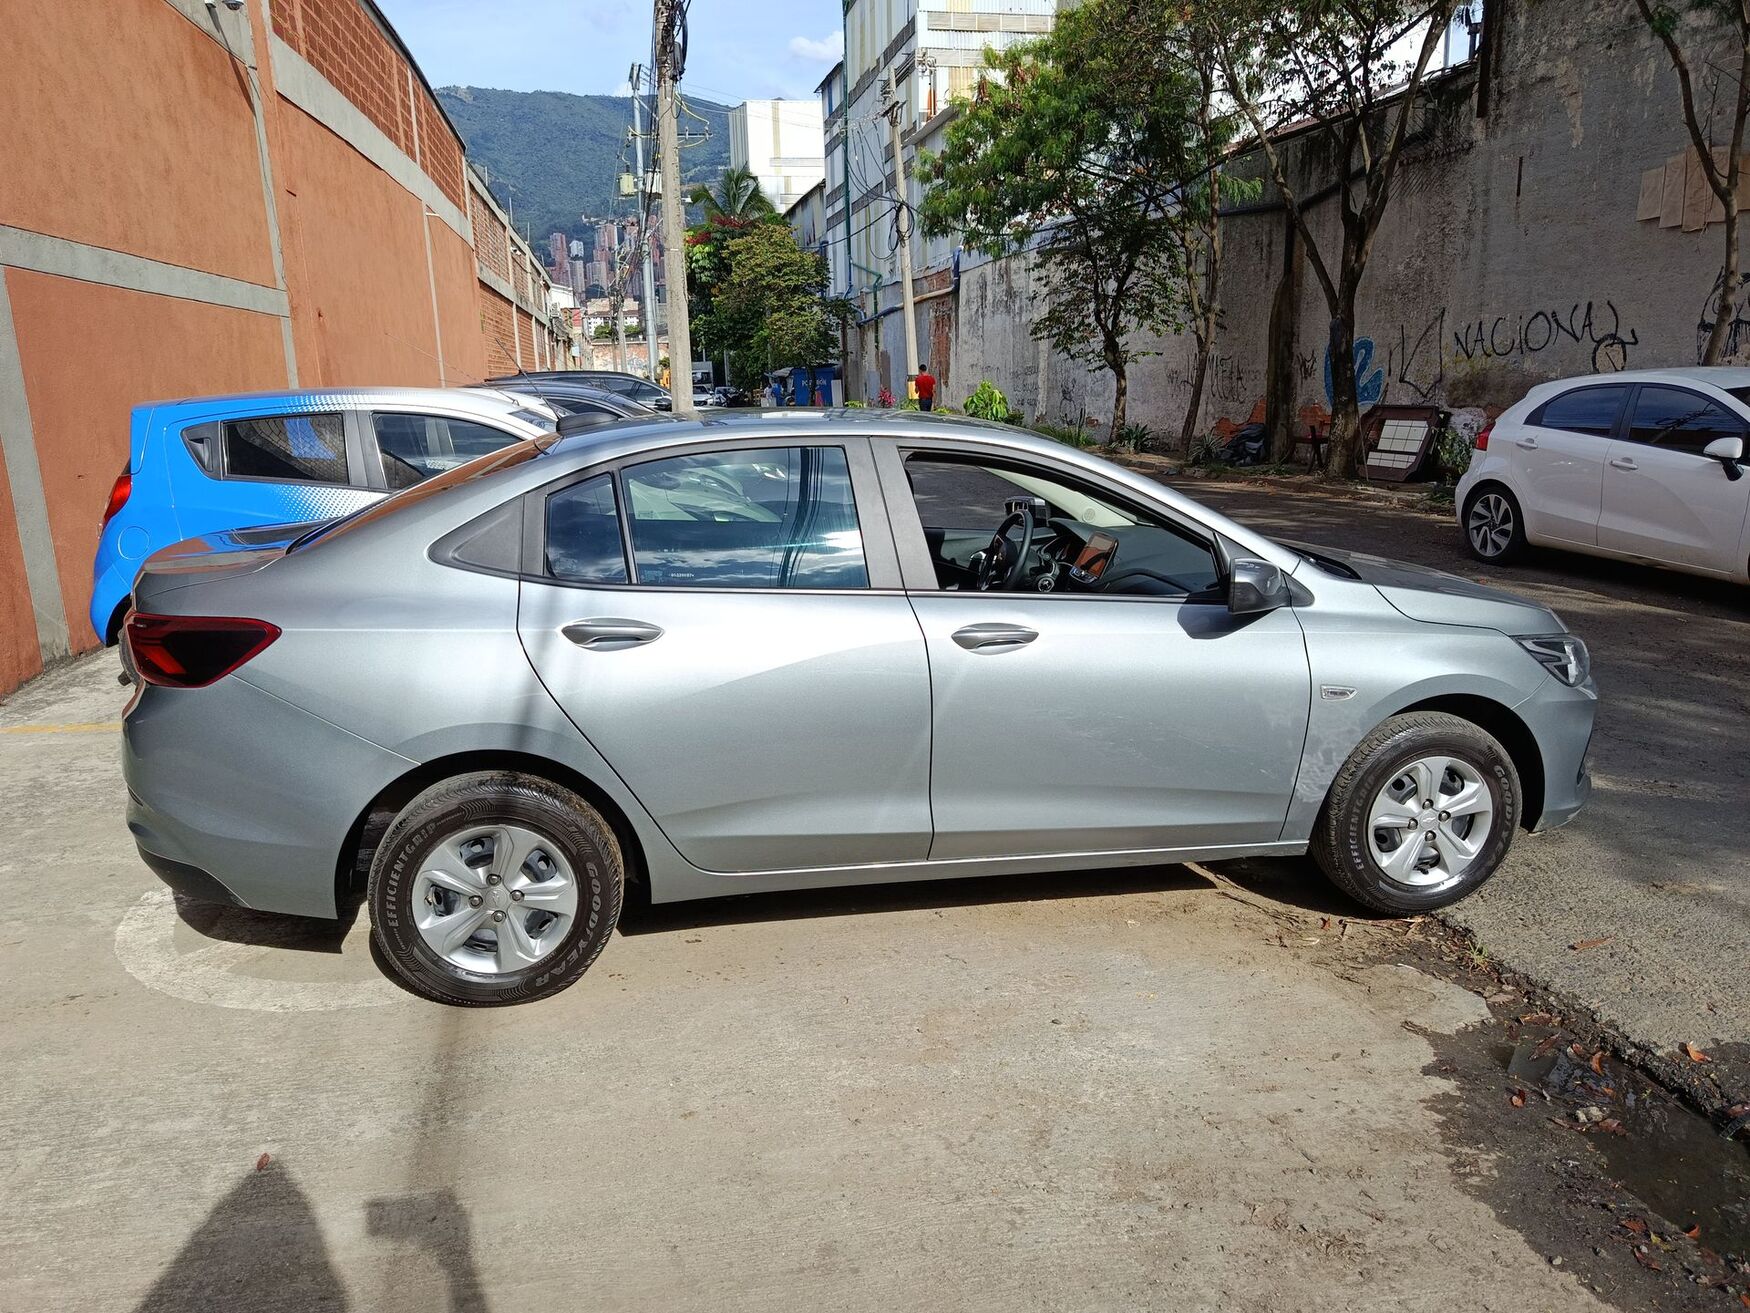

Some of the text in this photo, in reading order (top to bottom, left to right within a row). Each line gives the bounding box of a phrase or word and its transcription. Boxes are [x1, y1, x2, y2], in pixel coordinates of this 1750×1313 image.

[1454, 301, 1639, 360] NACIONAL
[1479, 765, 1513, 876] GOODYEA
[535, 861, 602, 987] GOODYEAR
